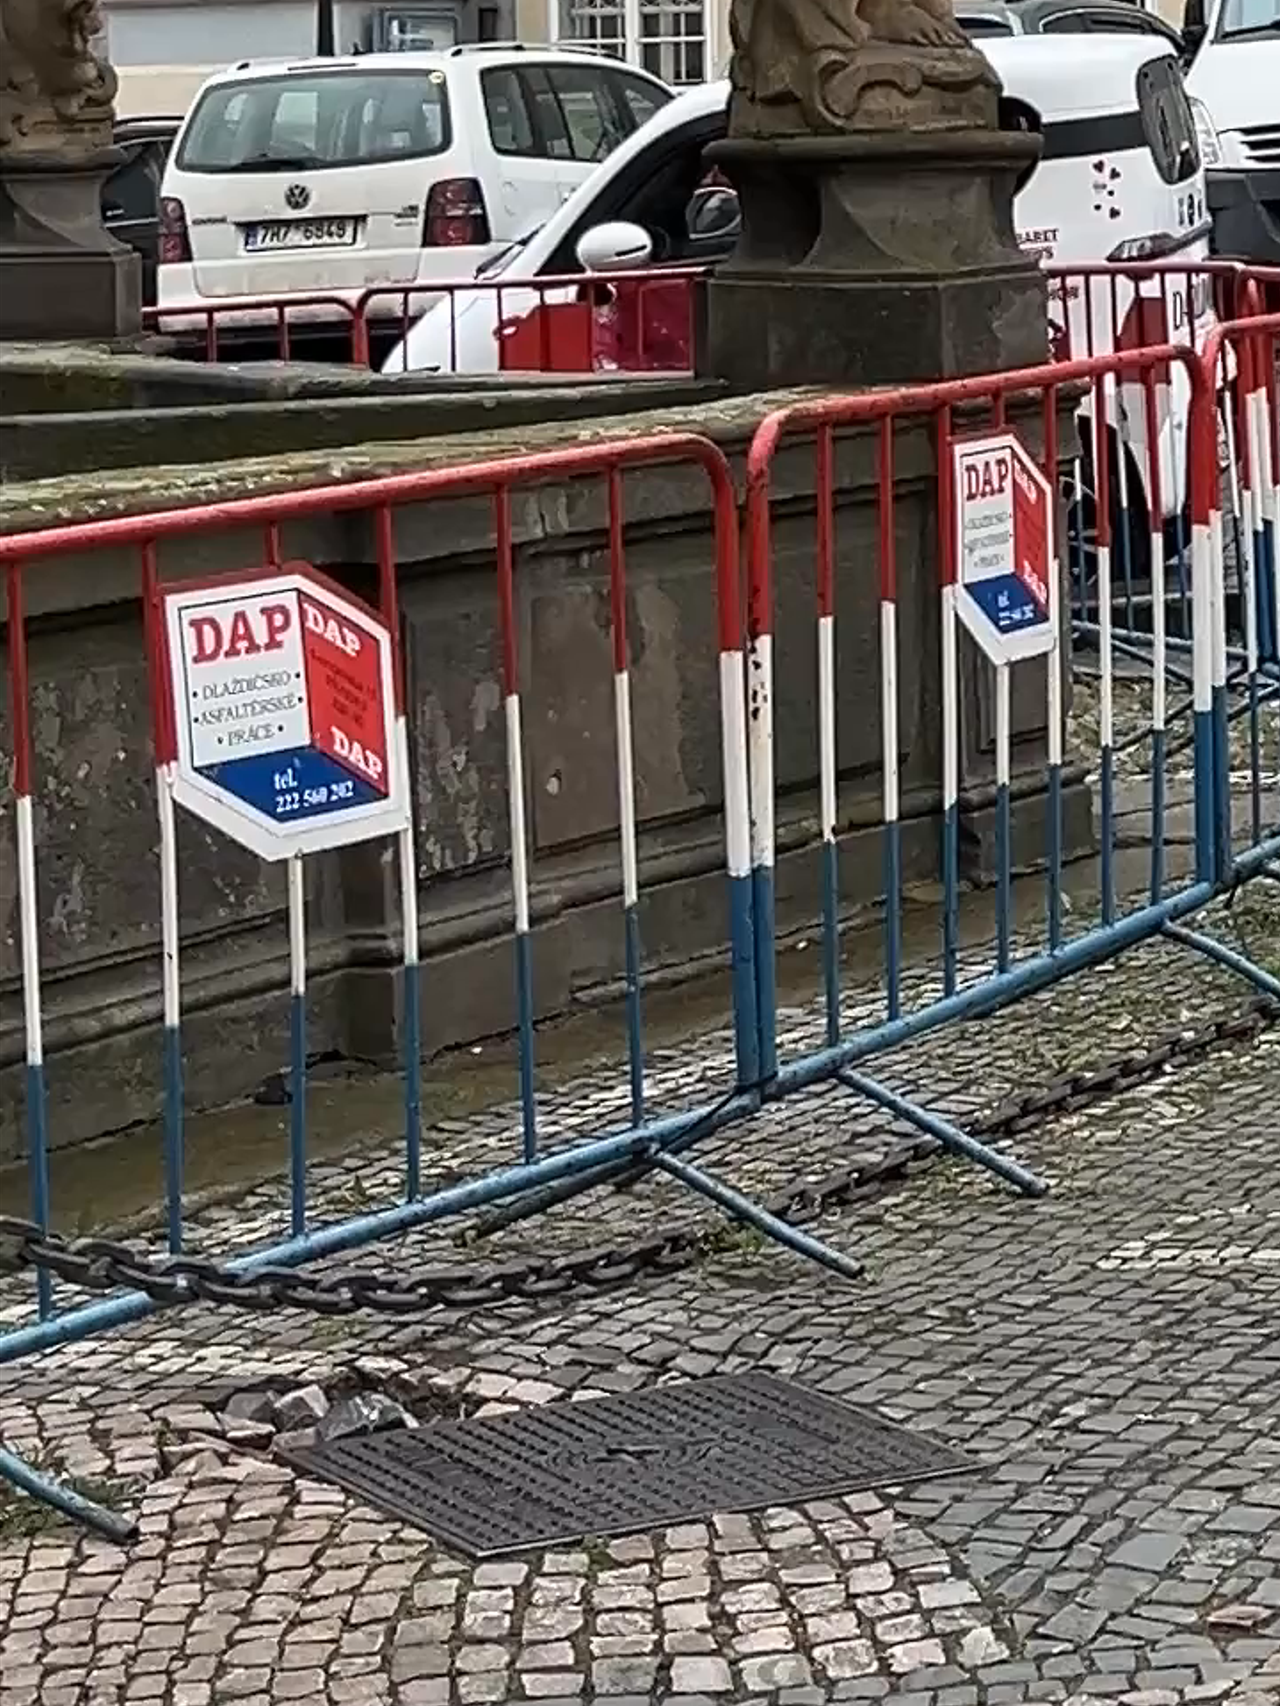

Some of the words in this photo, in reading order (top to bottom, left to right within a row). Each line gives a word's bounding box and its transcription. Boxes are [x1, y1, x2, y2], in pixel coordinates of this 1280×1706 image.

[964, 456, 1010, 503] DAP
[188, 604, 292, 664] DAP
[303, 602, 362, 656] DAP
[331, 726, 384, 779] DAP
